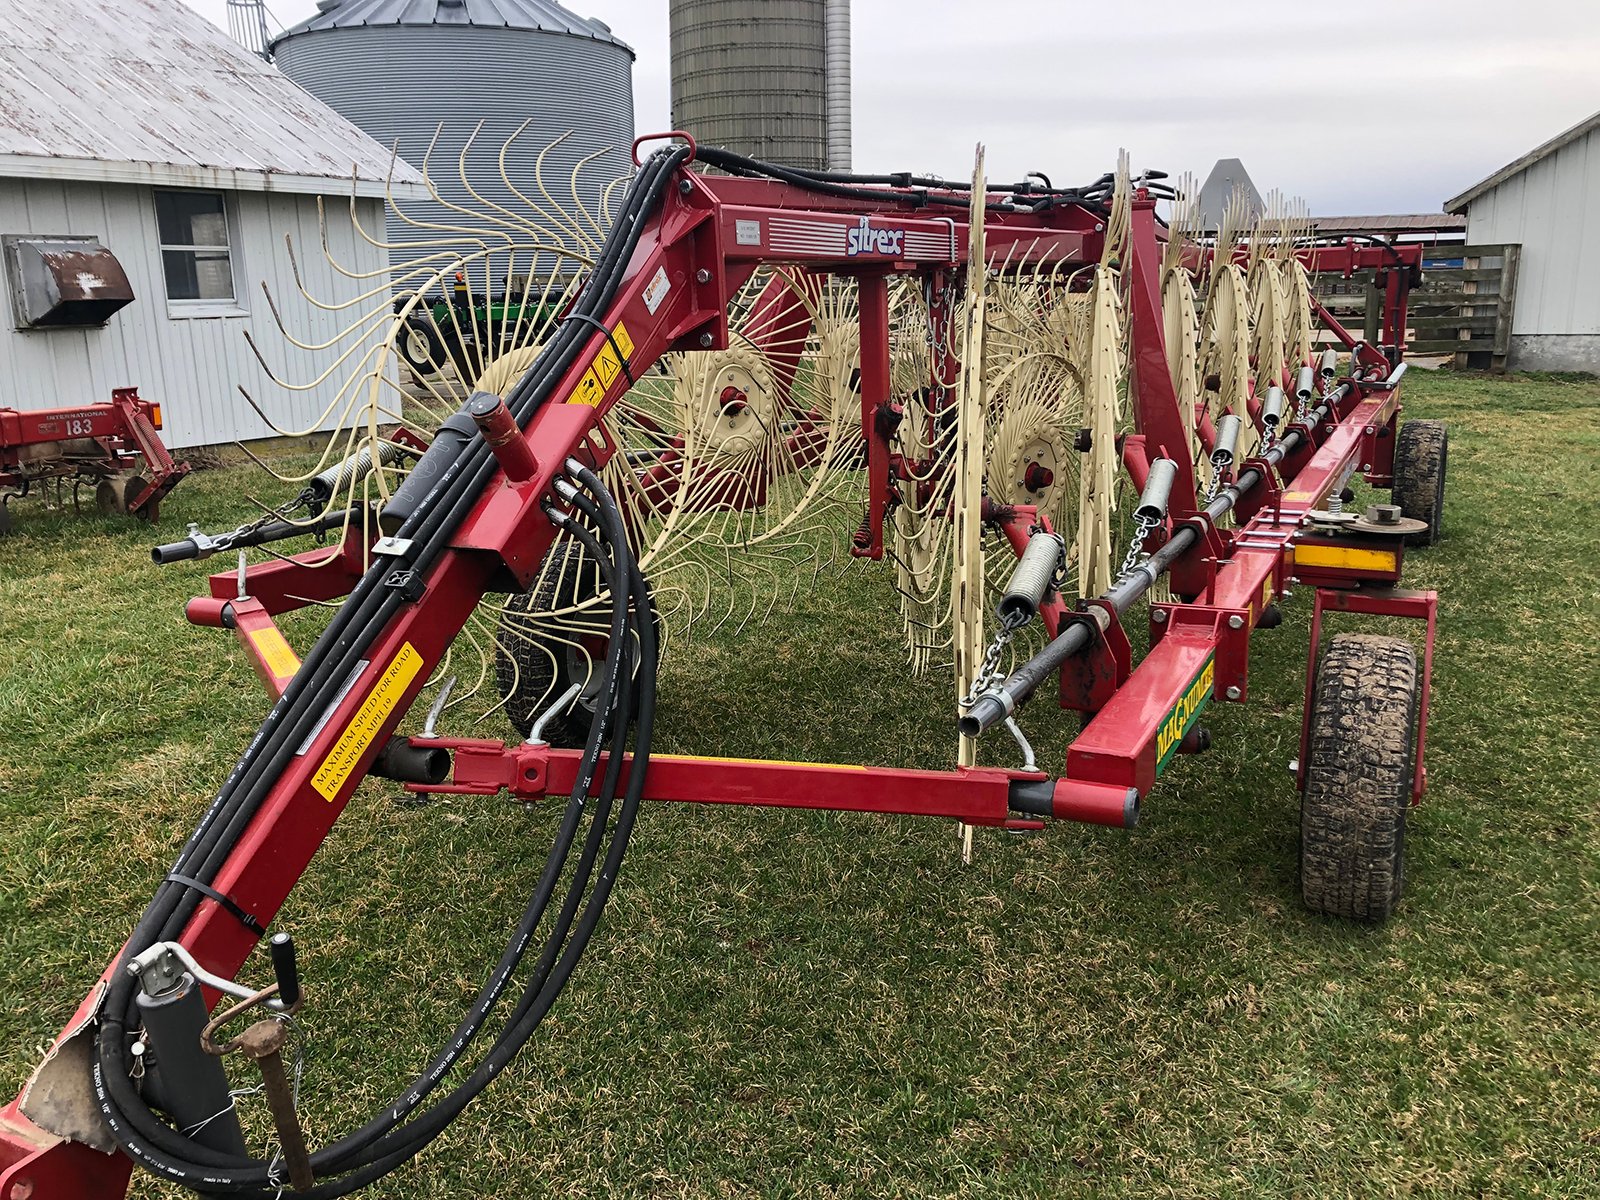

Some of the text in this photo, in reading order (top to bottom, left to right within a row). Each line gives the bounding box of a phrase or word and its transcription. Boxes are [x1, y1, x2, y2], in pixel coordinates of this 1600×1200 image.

[848, 216, 903, 255] sitrex
[46, 411, 107, 420] INTERNATIONAL
[66, 419, 92, 435] 183
[316, 648, 411, 786] MAXIMUM SPEED FOR ROAD
[325, 697, 392, 794] TRANSPORT MPH 19
